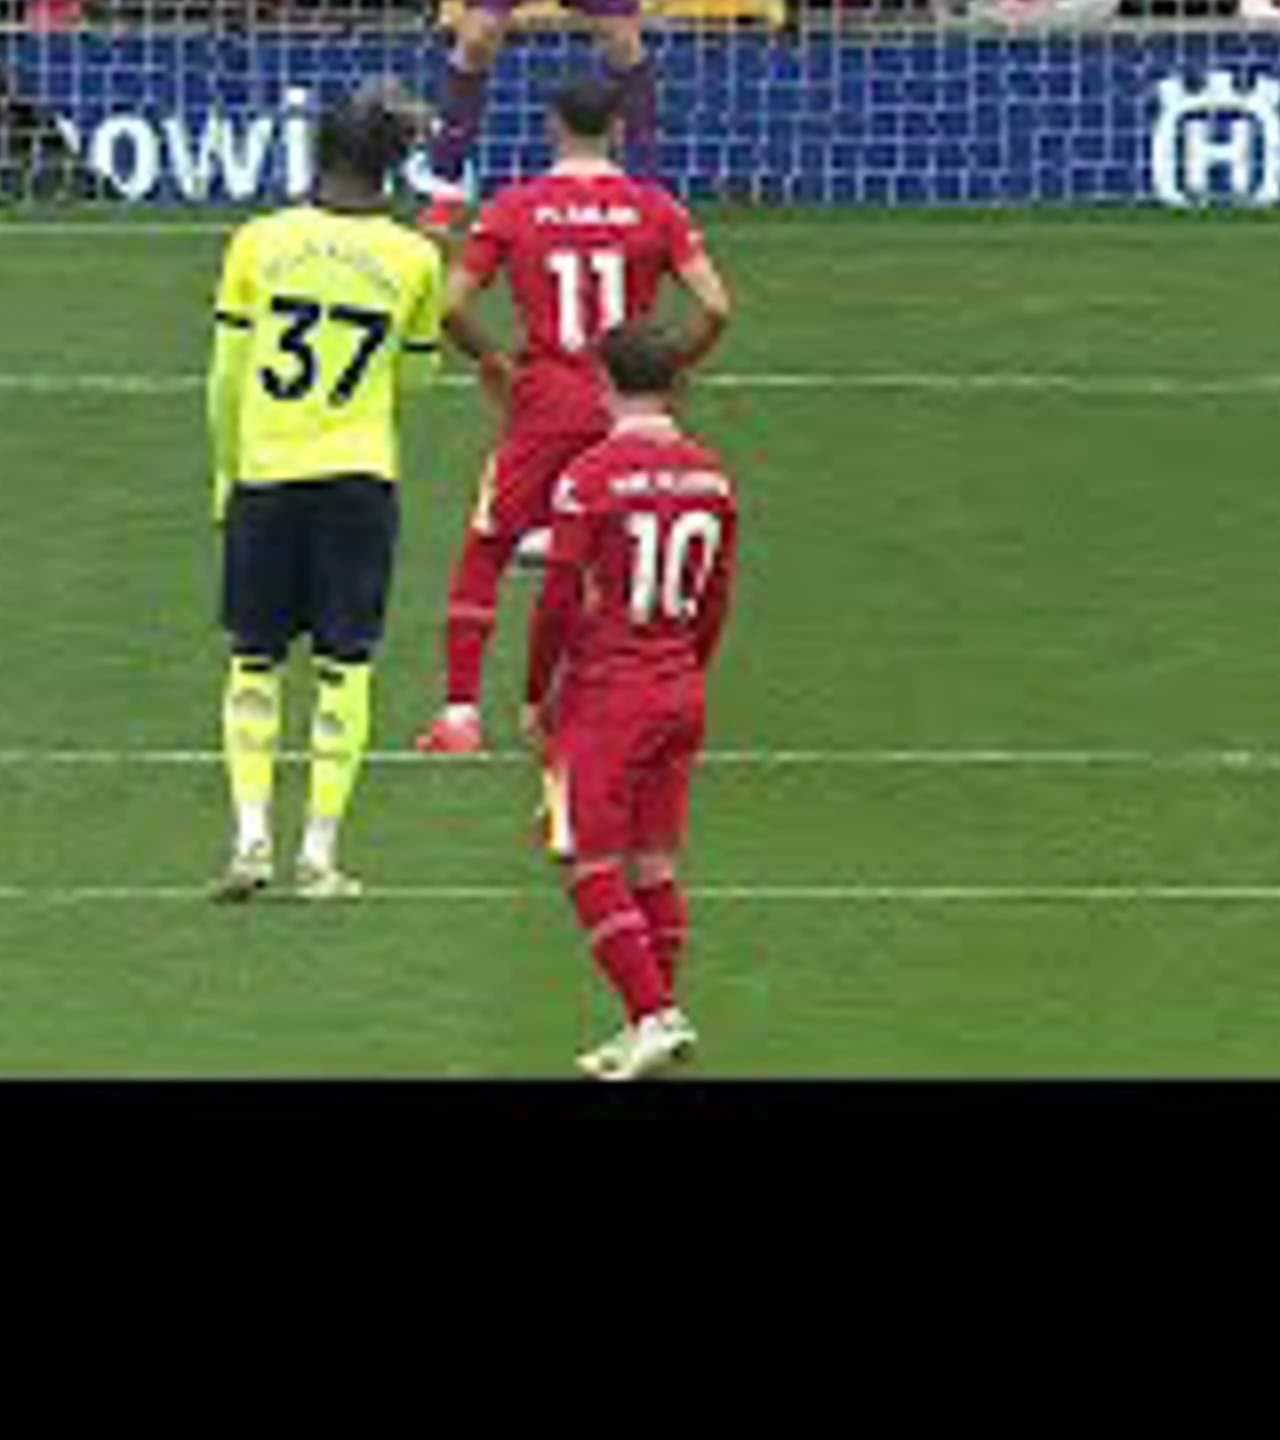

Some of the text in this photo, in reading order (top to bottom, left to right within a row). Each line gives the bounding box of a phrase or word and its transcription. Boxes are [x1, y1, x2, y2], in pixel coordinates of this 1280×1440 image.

[259, 294, 390, 407] 37
[547, 249, 626, 351] 11
[625, 510, 720, 624] 10
